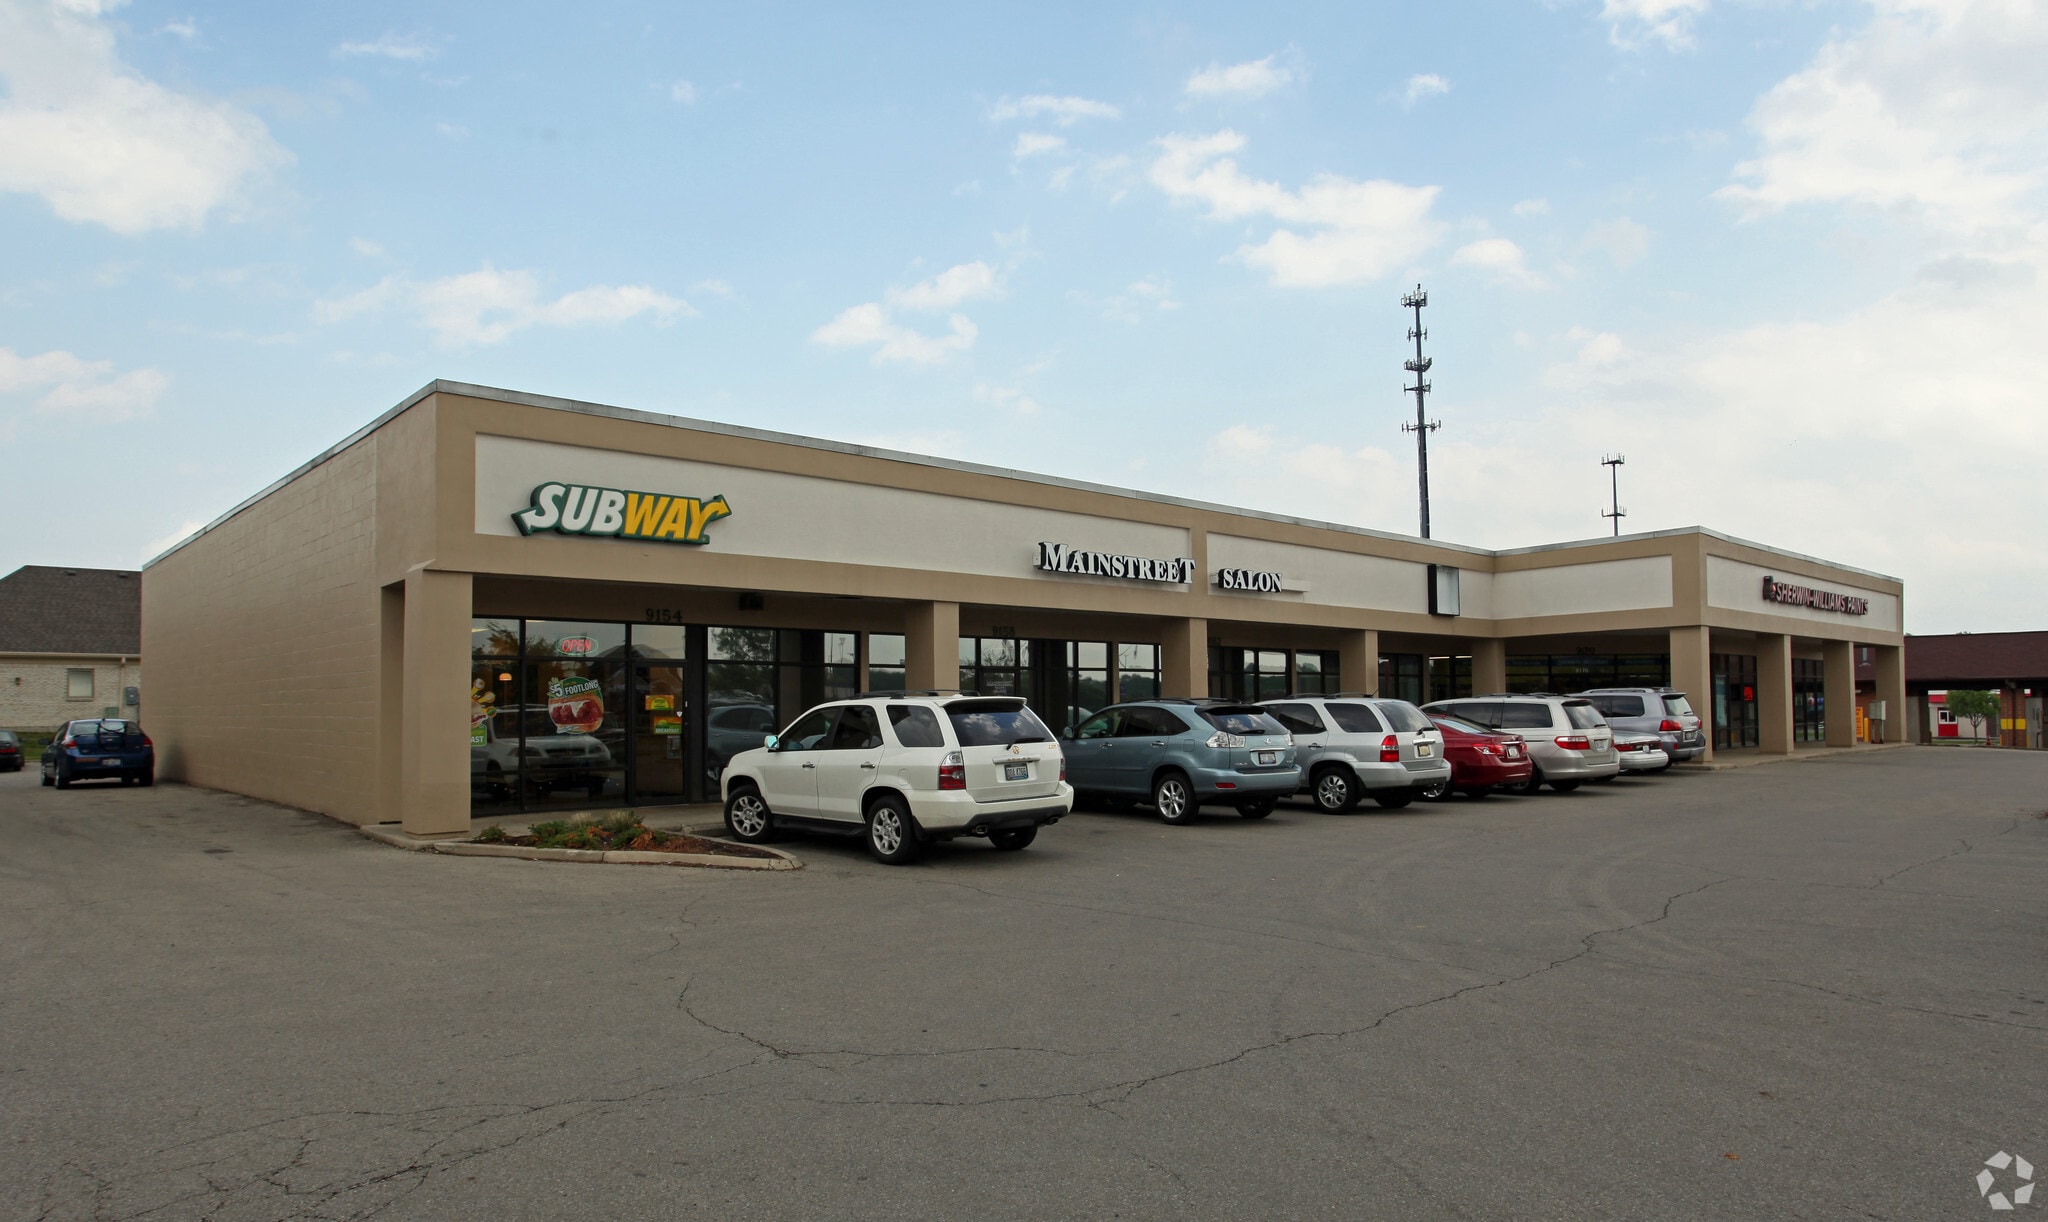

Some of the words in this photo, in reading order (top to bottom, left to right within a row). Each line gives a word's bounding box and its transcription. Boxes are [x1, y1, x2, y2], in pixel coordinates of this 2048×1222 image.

[514, 482, 732, 543] SUBWAY
[1218, 568, 1282, 593] SALON
[1776, 582, 1845, 613] SHERWIN-WILLIAMS
[1847, 596, 1868, 616] PAINTS
[645, 608, 683, 623] 9154
[561, 639, 593, 653] OPEN
[550, 683, 563, 698] $5
[564, 680, 599, 695] FOOTLONG
